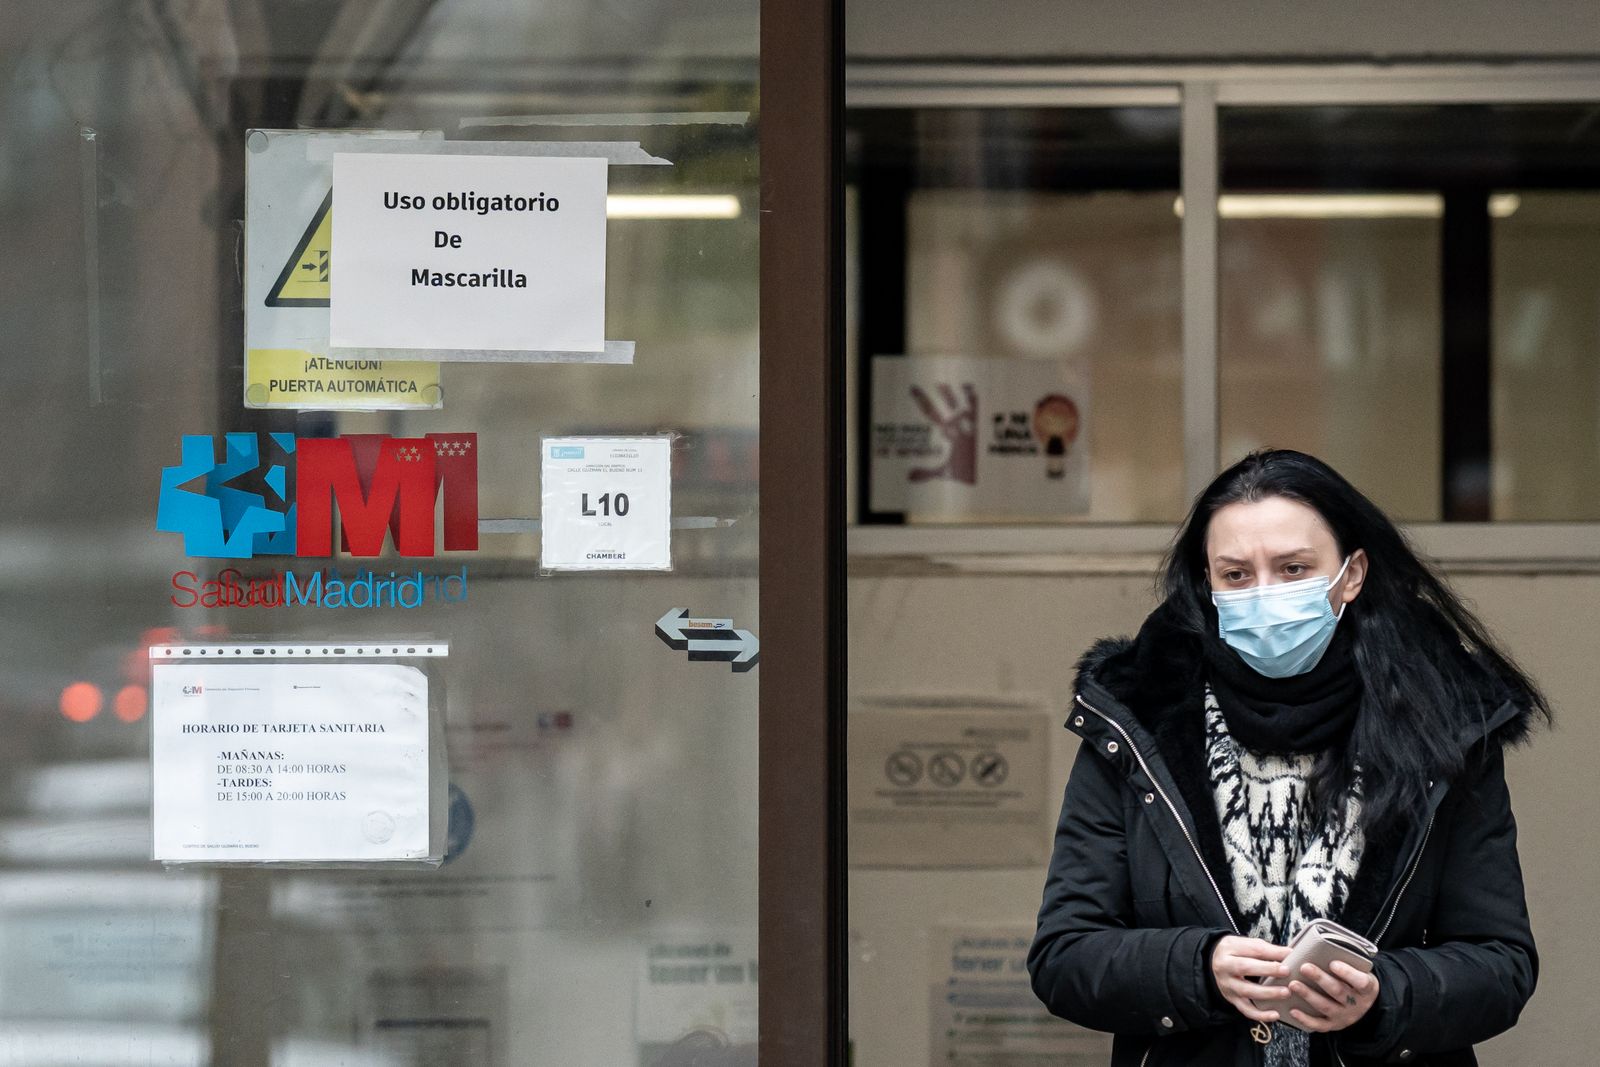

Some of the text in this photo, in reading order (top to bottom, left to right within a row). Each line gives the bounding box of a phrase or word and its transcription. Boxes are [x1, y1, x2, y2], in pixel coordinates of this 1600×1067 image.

[384, 191, 560, 216] Uso obligatorio
[434, 231, 462, 249] De
[411, 269, 528, 288] Mascarilla
[269, 377, 418, 393] PUERTA AUTOMÁTICA
[581, 492, 630, 517] L10
[586, 552, 626, 560] CHAMBERÍ
[171, 570, 423, 609] Salud Madrid
[182, 723, 386, 734] HORARIO DE TARJETA SANITARIA
[217, 749, 285, 761] -MAÑANAS:
[217, 763, 347, 774] DE 08:30 A 14:00 HORAS
[217, 778, 273, 788] -TARDES:
[217, 791, 347, 801] DE 15:00 A 20:00 HORAS
